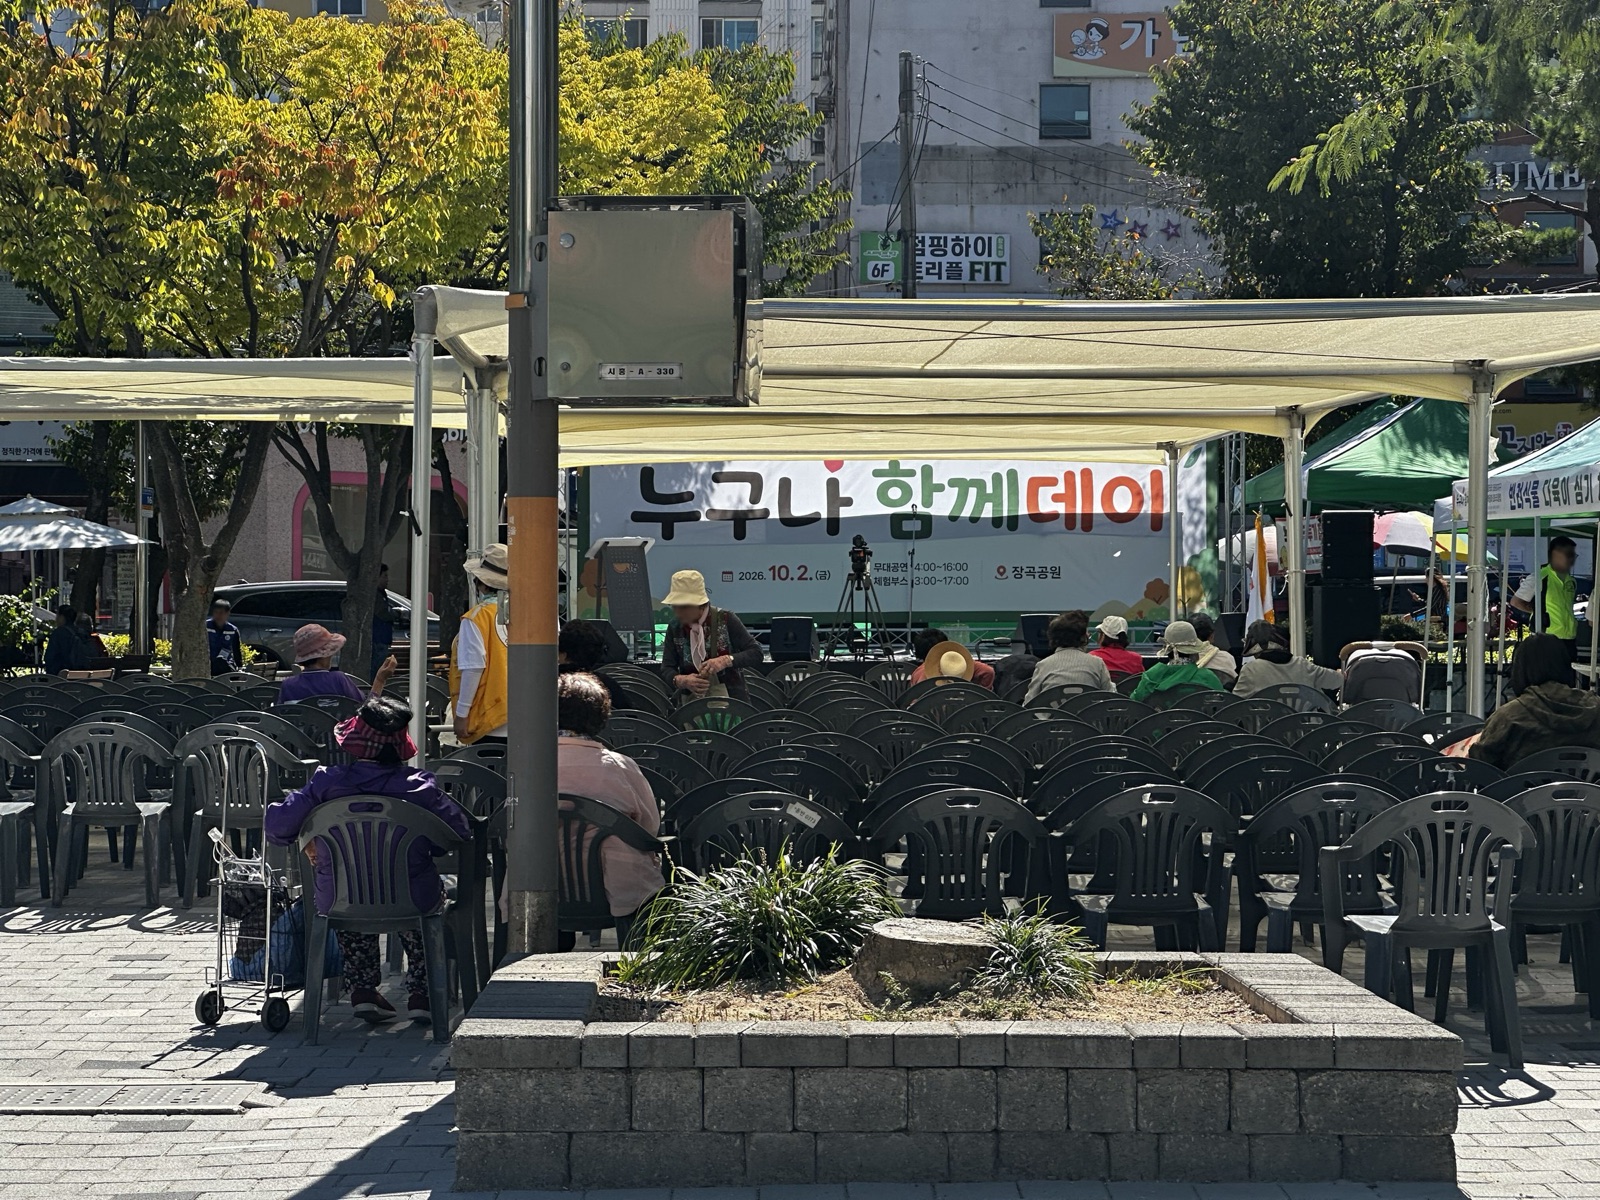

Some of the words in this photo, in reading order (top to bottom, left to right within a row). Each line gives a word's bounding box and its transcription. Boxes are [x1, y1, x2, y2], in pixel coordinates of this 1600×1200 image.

[871, 263, 890, 278] 6F
[968, 261, 1007, 281] FIT
[656, 367, 675, 376] 330
[1542, 476, 1571, 507] 다육이
[1573, 473, 1594, 505] 심기
[630, 462, 854, 541] 누구나
[873, 562, 908, 573] 무대공연
[911, 562, 969, 572] 4:00~16:00
[1011, 565, 1062, 579] 장곡공원
[738, 571, 767, 581] 2026.
[873, 576, 908, 587] 체험부스
[911, 576, 969, 586] 3:00~17:00
